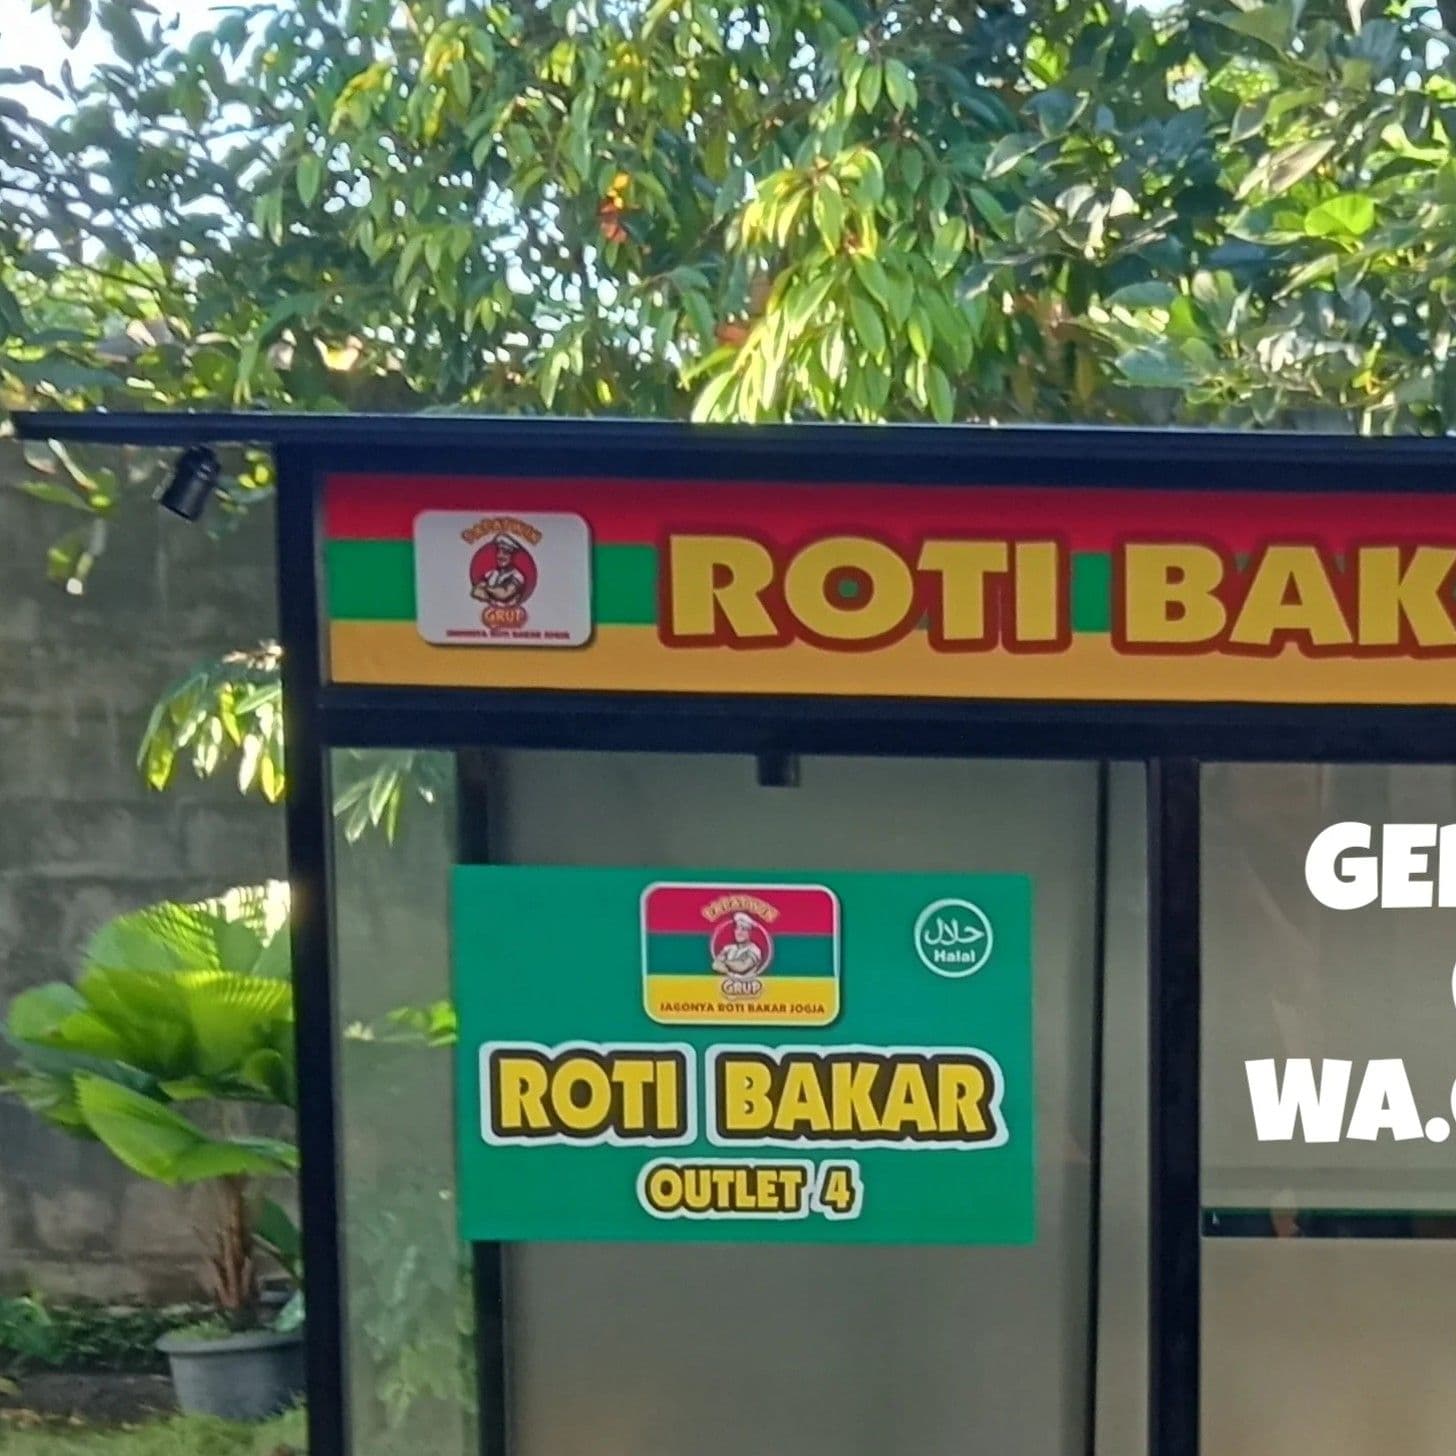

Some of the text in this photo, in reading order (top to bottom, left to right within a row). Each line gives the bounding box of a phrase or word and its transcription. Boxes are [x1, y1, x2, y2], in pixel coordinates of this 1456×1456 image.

[668, 533, 1058, 642] ROTI
[933, 948, 976, 963] Halal
[722, 979, 763, 995] GRUP
[499, 1057, 987, 1133] ROTI BAKAR
[645, 1169, 854, 1209] OUTLET 4
